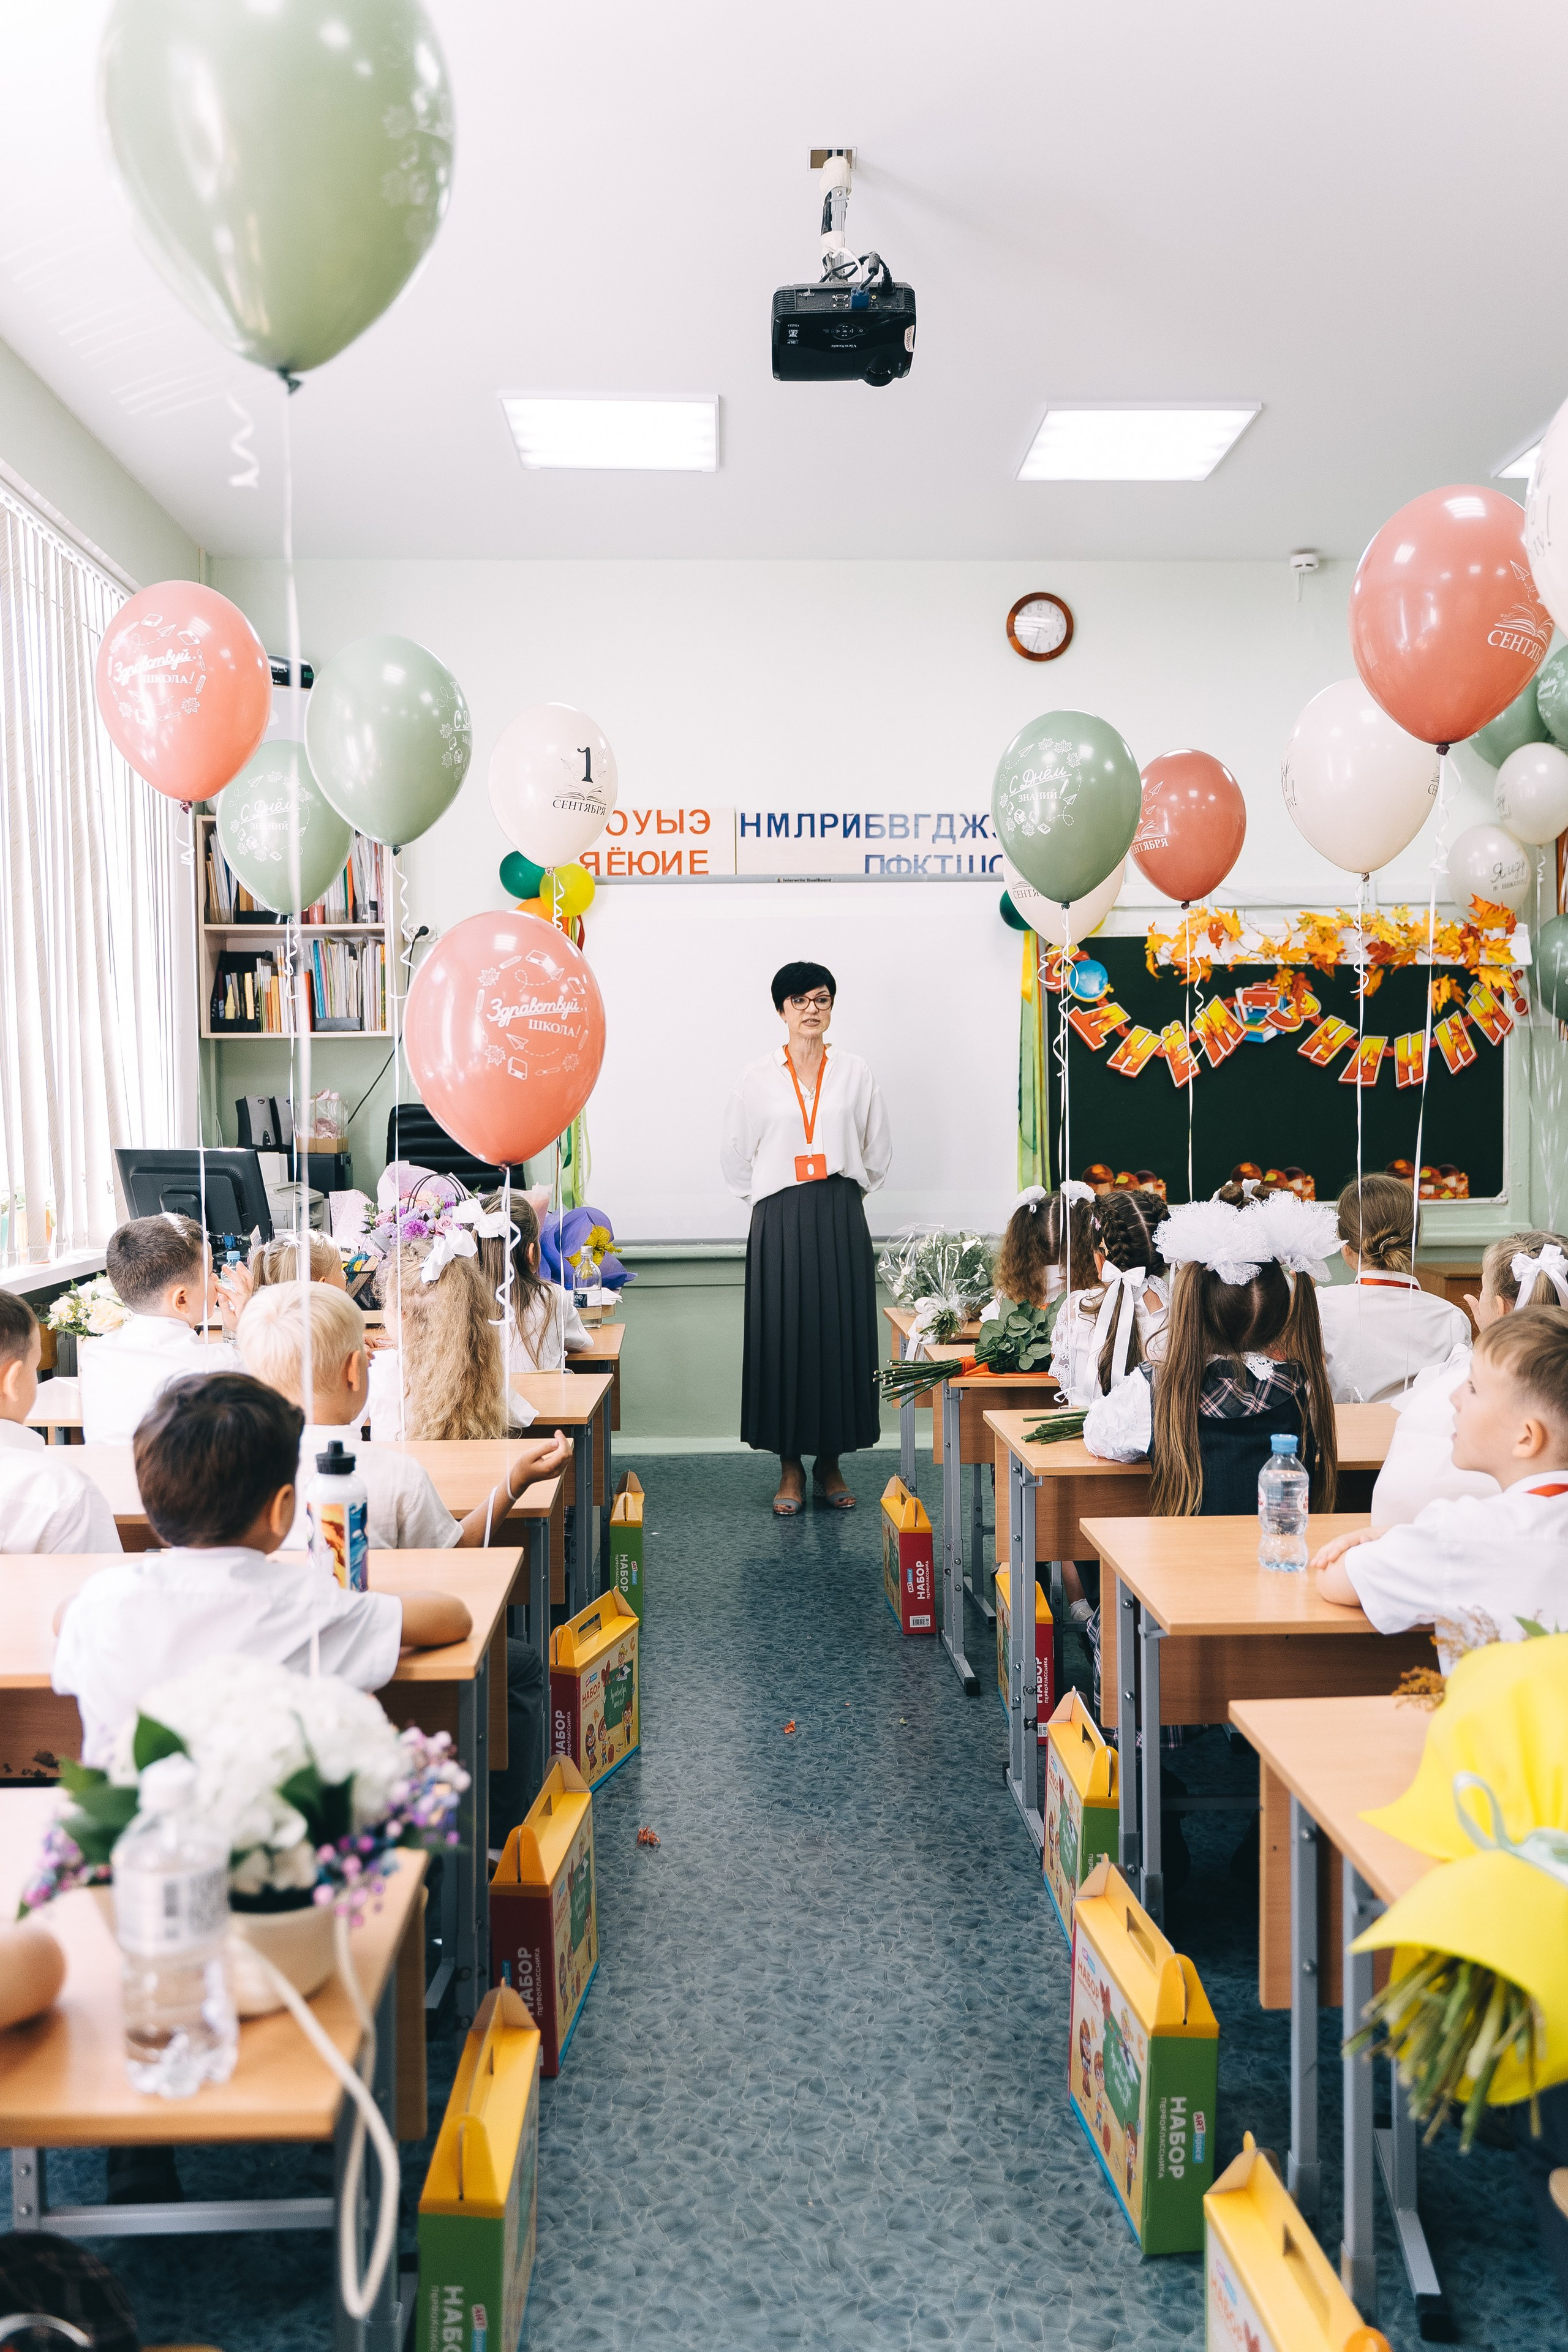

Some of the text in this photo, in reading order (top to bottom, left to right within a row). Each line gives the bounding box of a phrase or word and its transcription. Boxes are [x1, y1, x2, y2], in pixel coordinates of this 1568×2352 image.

[577, 747, 594, 783] 1
[552, 799, 606, 816] СЕНТЯБРЯ
[1131, 838, 1169, 854] ЕНТЯБРЯ
[1013, 889, 1042, 899] СЕНТЯ
[528, 1019, 581, 1038] ШКОЛА!
[1068, 994, 1248, 1088] ДНЁМ
[620, 1554, 628, 1592] НАБОР
[916, 1561, 925, 1599] НАБОР
[582, 1681, 601, 1705] НАБОР
[518, 1947, 534, 2016] АБОР
[535, 1948, 543, 2016] ПЕРВОКЛАССНИКА
[1078, 1956, 1099, 2000] НАБОР
[1158, 2097, 1167, 2178] ПЕРВОКЛАССНИКА
[1168, 2097, 1187, 2178] НАБОР
[1195, 2114, 1205, 2132] ART
